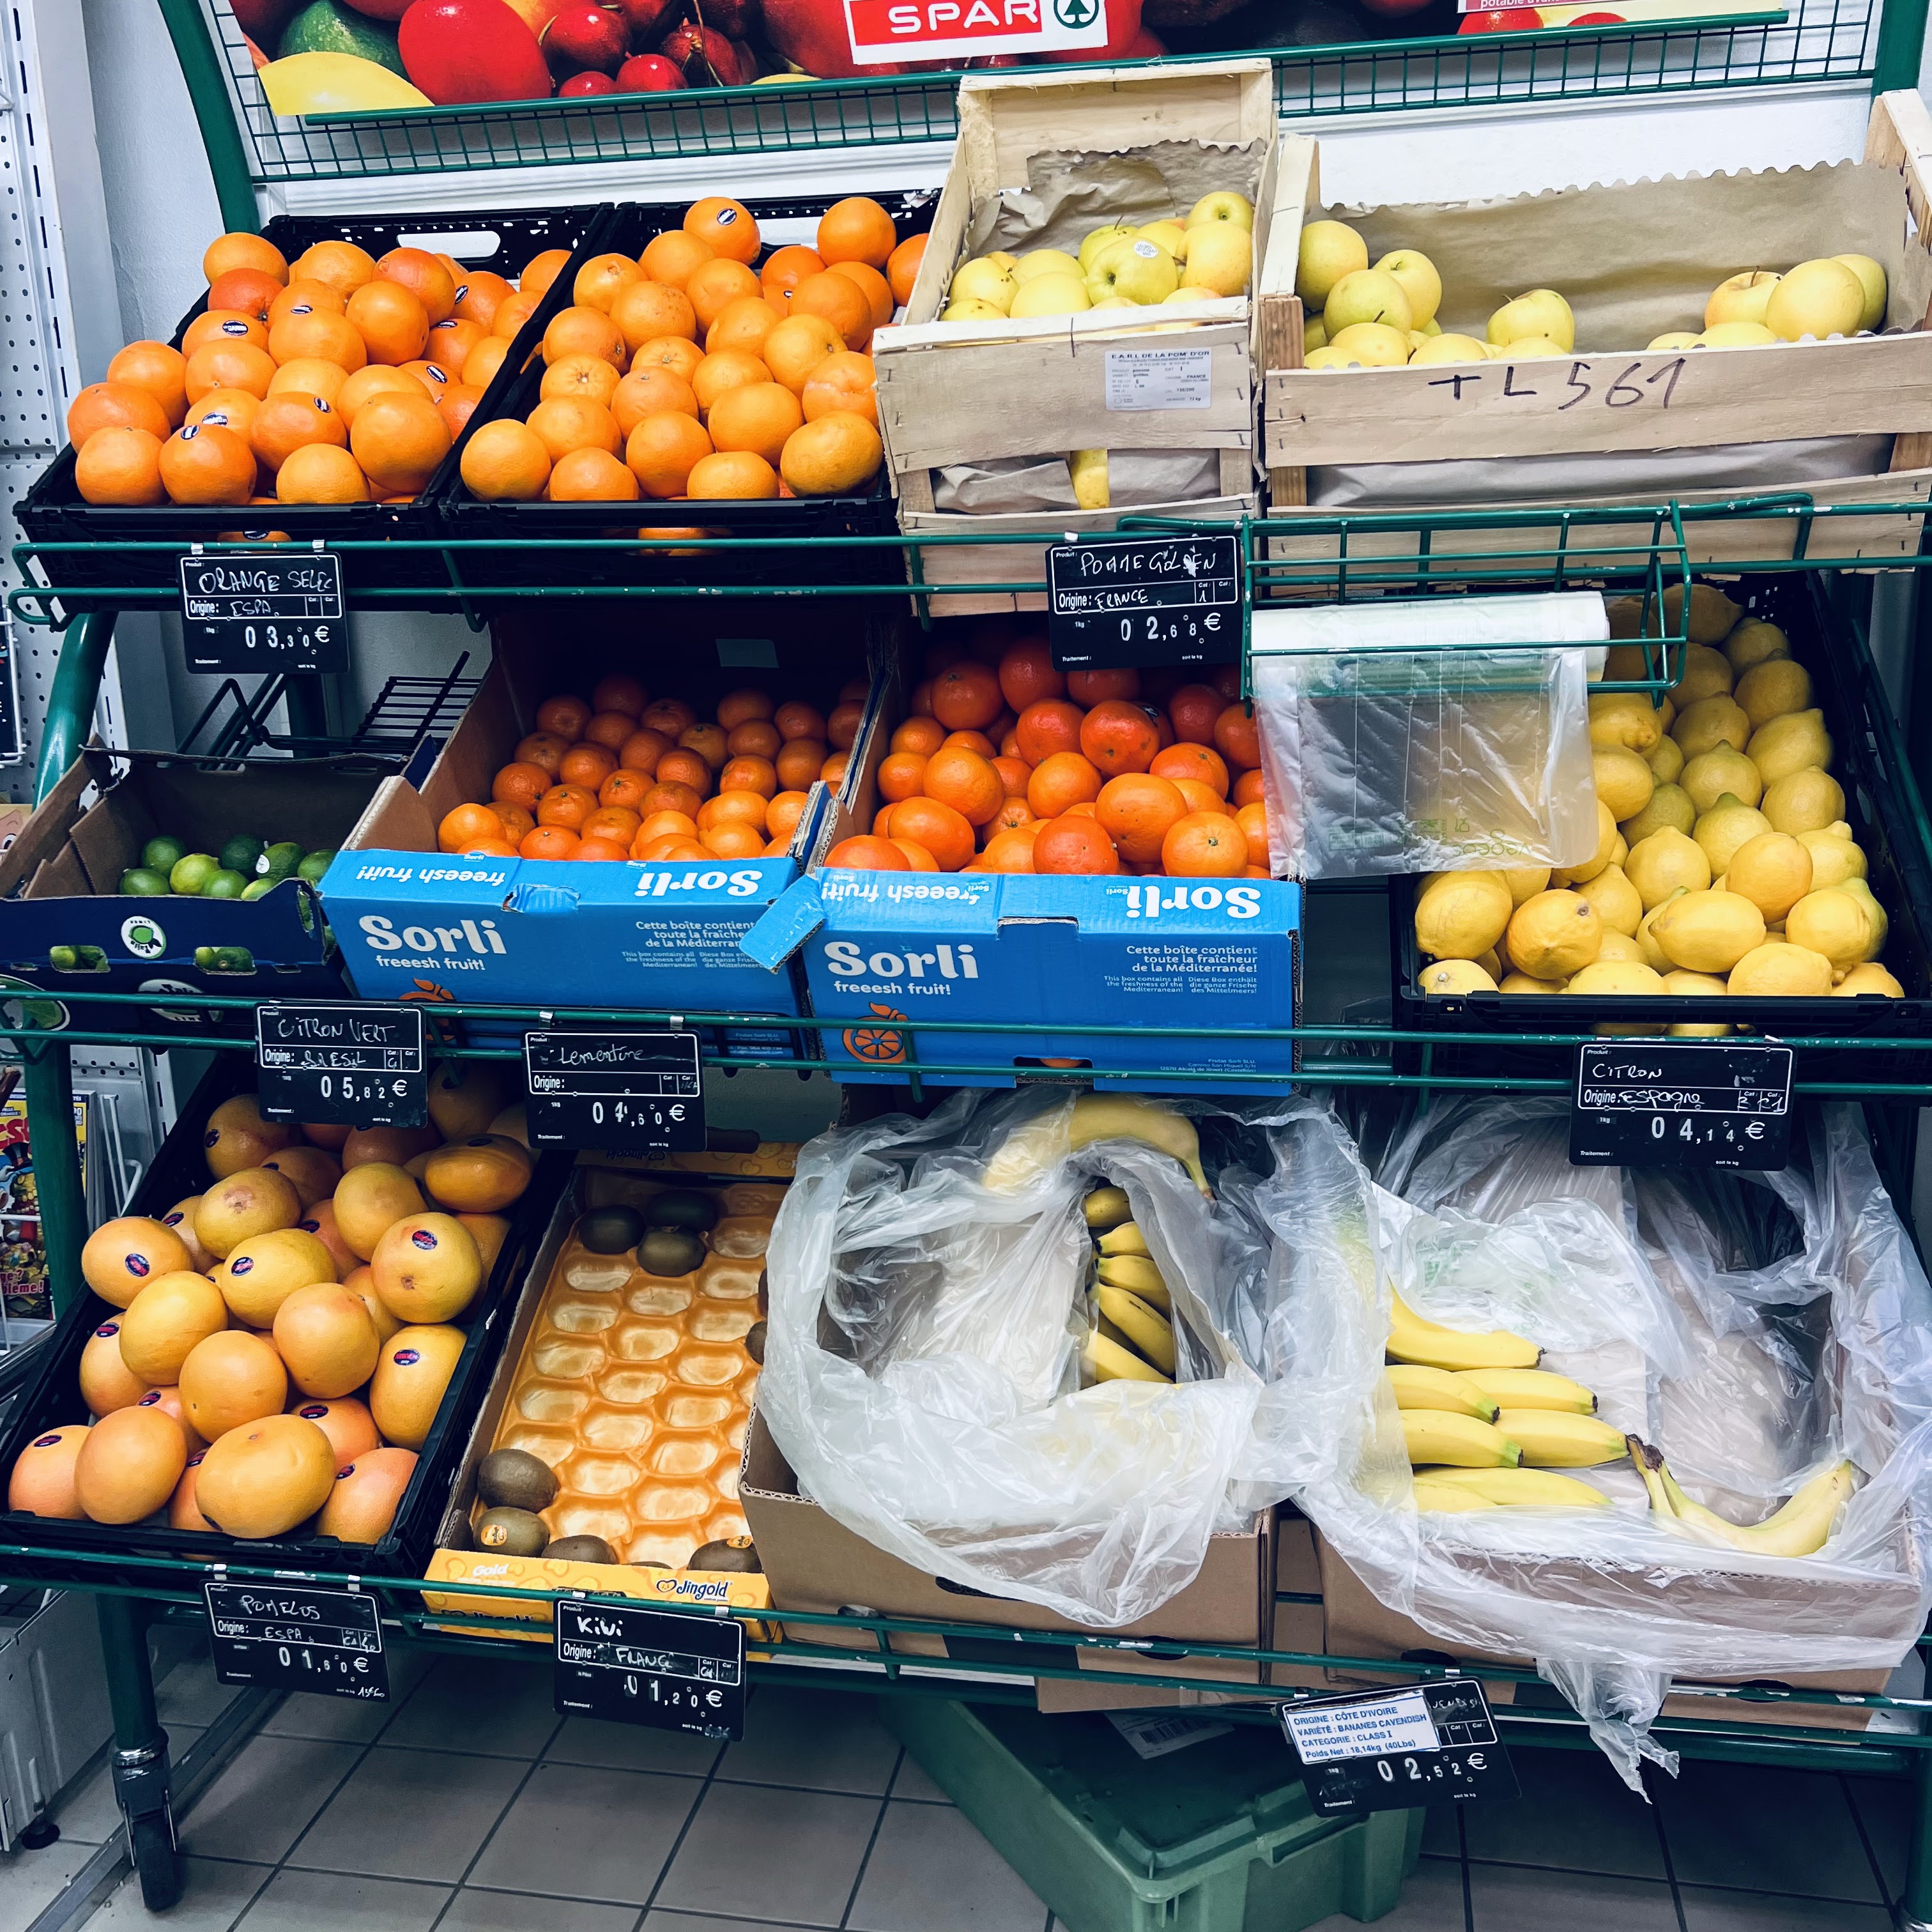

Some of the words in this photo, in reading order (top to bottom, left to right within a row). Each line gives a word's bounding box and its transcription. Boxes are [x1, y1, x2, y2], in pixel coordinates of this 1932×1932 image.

[889, 0, 1038, 34] SPAR
[199, 567, 280, 594] ORANGE
[1094, 589, 1149, 609] FRANCE
[356, 866, 413, 882] fruit!
[419, 869, 505, 886] freeesh
[634, 870, 763, 897] Sorli
[821, 882, 879, 902] fruit!
[1126, 885, 1261, 919] Sorli
[359, 915, 507, 954] Sorli
[636, 921, 668, 930] Cette
[670, 921, 702, 930] boîte
[705, 921, 755, 930] contient
[654, 930, 687, 939] toute
[689, 930, 700, 939] la
[703, 930, 744, 939] fraîche
[663, 939, 673, 947] la
[1126, 946, 1161, 954] Cette
[1164, 945, 1198, 954] boîte
[1201, 946, 1257, 954] contient
[376, 955, 441, 969] freeesh
[444, 958, 486, 970] fruit!
[824, 941, 979, 979] Sorli
[1132, 963, 1147, 972] de
[1151, 963, 1162, 972] la
[1166, 963, 1257, 972] Méditerranée!
[1144, 955, 1179, 963] toute
[1183, 954, 1193, 963] la
[1197, 954, 1258, 963] fraîcheur
[834, 981, 902, 993] freeesh
[907, 983, 951, 995] fruit!
[349, 1018, 396, 1043] VERT
[473, 1563, 509, 1576] Gold
[677, 1580, 728, 1600] Jingold
[1294, 1715, 1329, 1725] ORIGINE
[1335, 1712, 1359, 1721] CÔTE
[1361, 1706, 1398, 1718] D'IVOIRE
[1298, 1725, 1333, 1736] VARIÉTÉ
[1337, 1721, 1377, 1732] BANANES
[1379, 1714, 1427, 1727] CAVENDISH
[1301, 1736, 1351, 1747] CATEGORIE
[1357, 1731, 1386, 1741] CLASS
[1305, 1747, 1329, 1758] Poids
[1330, 1747, 1344, 1756] Net
[1385, 1739, 1416, 1751] (40Lbs)
